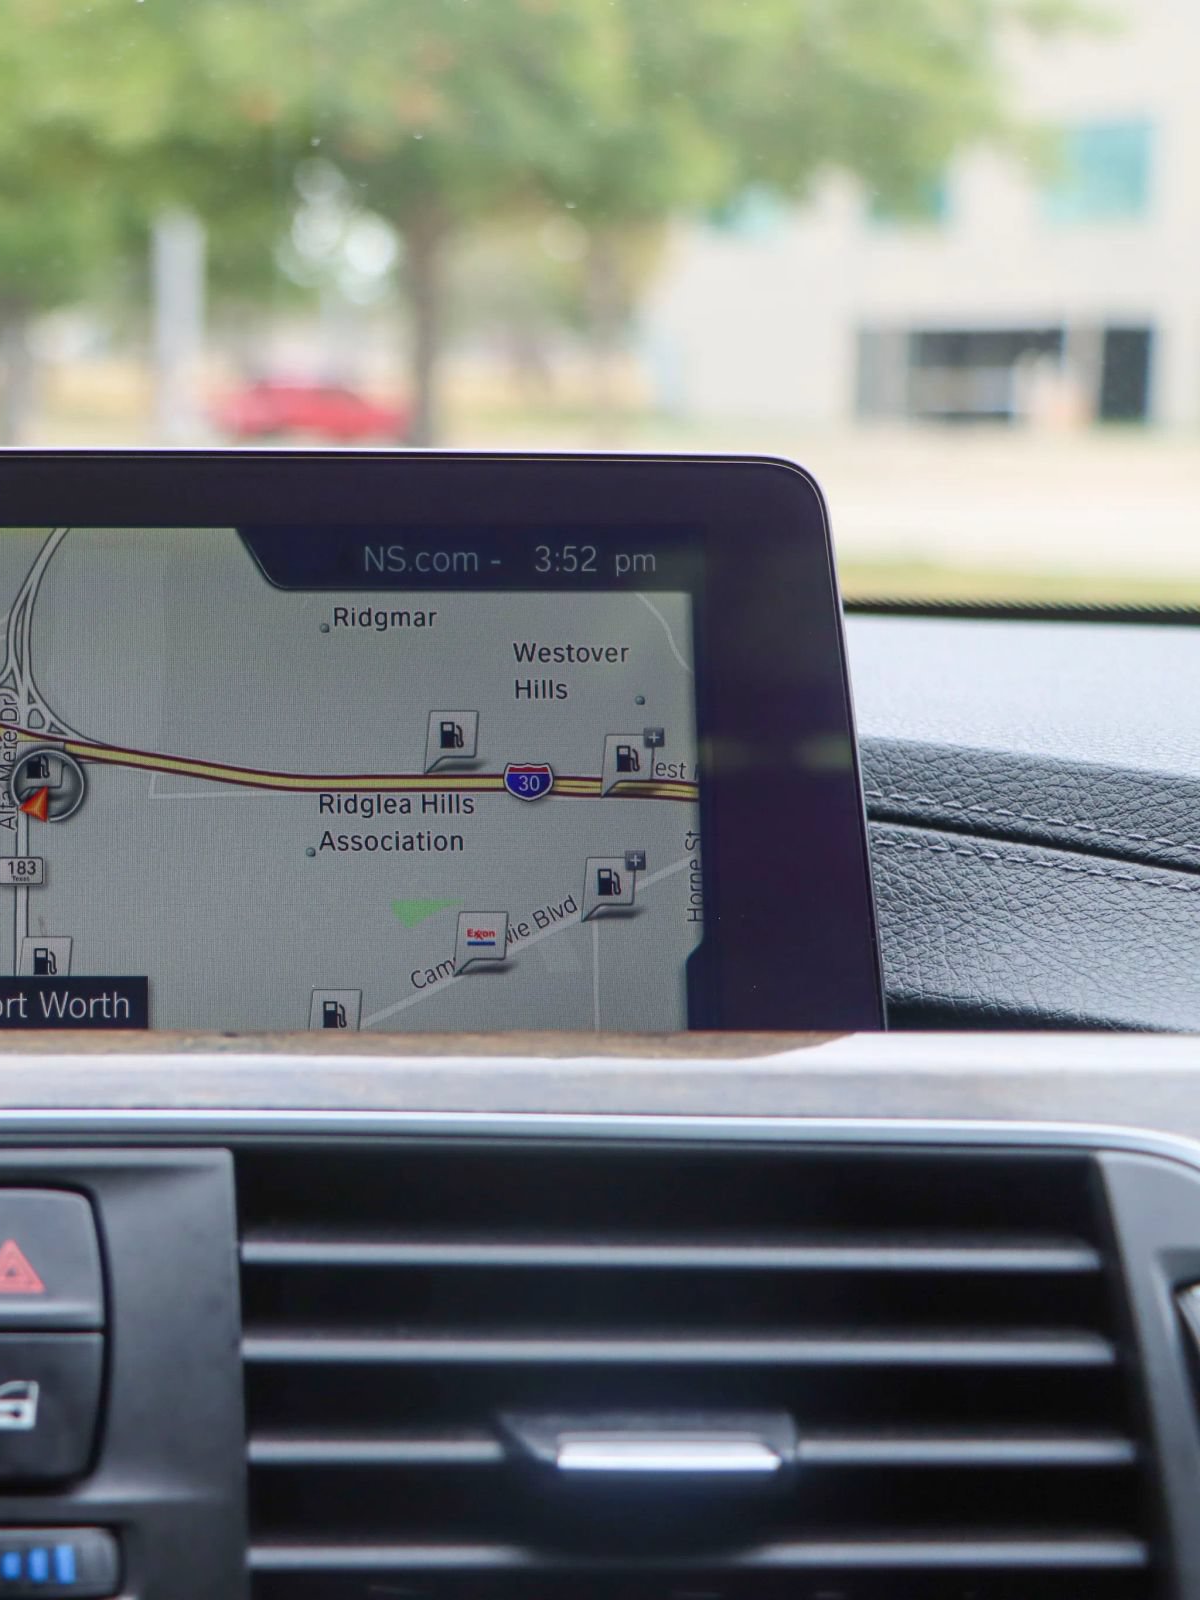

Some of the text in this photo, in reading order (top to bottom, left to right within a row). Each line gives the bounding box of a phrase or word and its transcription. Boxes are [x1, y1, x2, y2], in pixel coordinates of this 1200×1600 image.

[363, 545, 479, 573] NS.com
[534, 545, 656, 577] 3:52 pm
[332, 606, 437, 632] Ridgmar
[513, 642, 630, 663] Westover
[514, 679, 568, 700] Hills
[0, 698, 18, 722] Dr
[0, 730, 18, 782] Mere
[654, 761, 687, 780] est
[518, 775, 540, 793] 30
[318, 792, 475, 817] Ridglea Hills
[318, 830, 465, 852] Association
[7, 860, 37, 876] 183
[684, 830, 703, 922] Horne St
[410, 956, 456, 989] Cam
[532, 894, 578, 930] Blvd
[40, 991, 130, 1019] Worth
